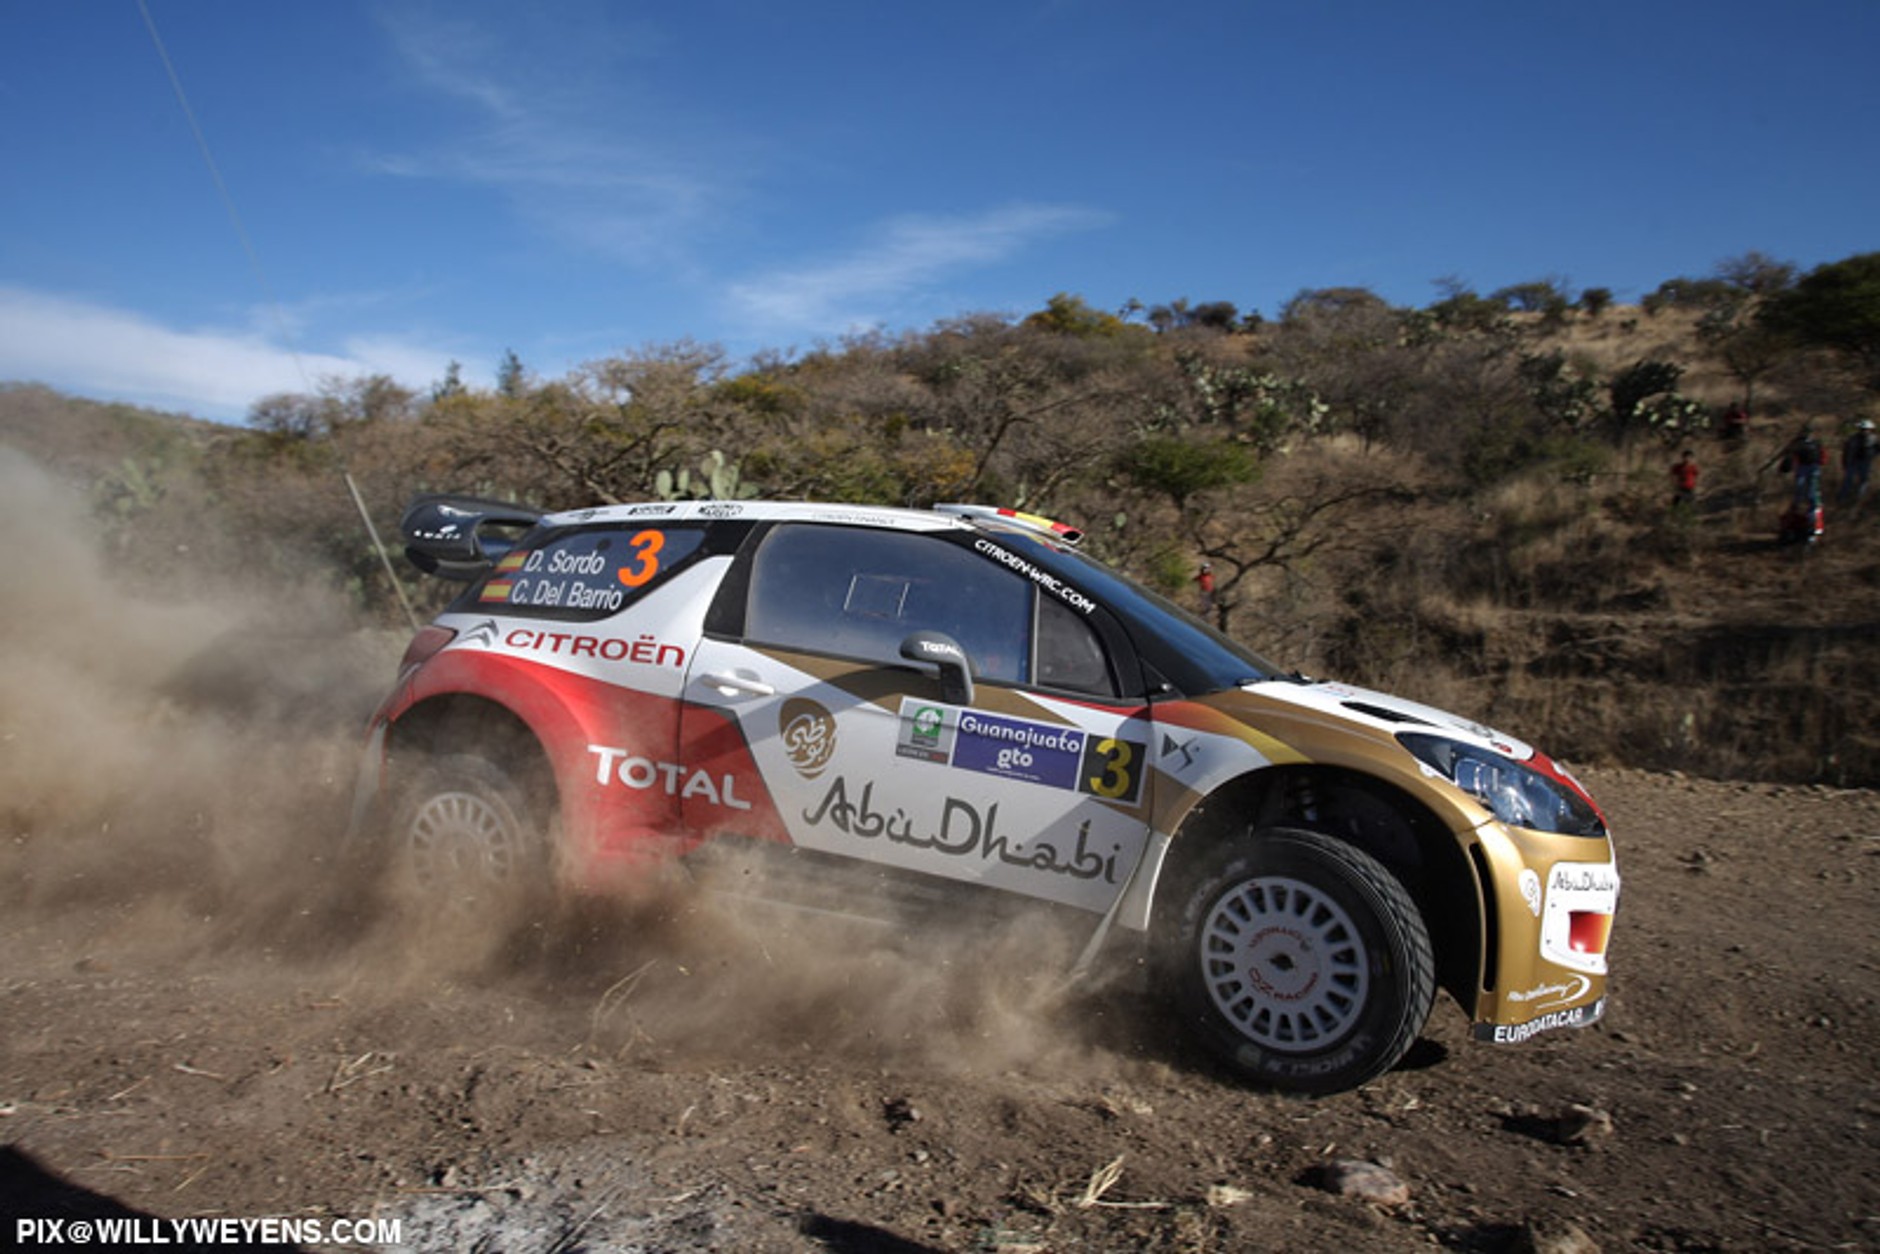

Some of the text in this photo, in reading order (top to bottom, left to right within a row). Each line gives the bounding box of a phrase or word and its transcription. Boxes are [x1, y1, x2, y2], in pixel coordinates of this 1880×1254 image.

[524, 549, 606, 574] D. Sordo
[617, 530, 666, 587] 3
[511, 579, 623, 610] C. Del Barrio
[961, 716, 1081, 753] Guanajuato
[587, 744, 752, 810] TOTAL
[997, 748, 1034, 769] gto
[1090, 739, 1132, 798] 3
